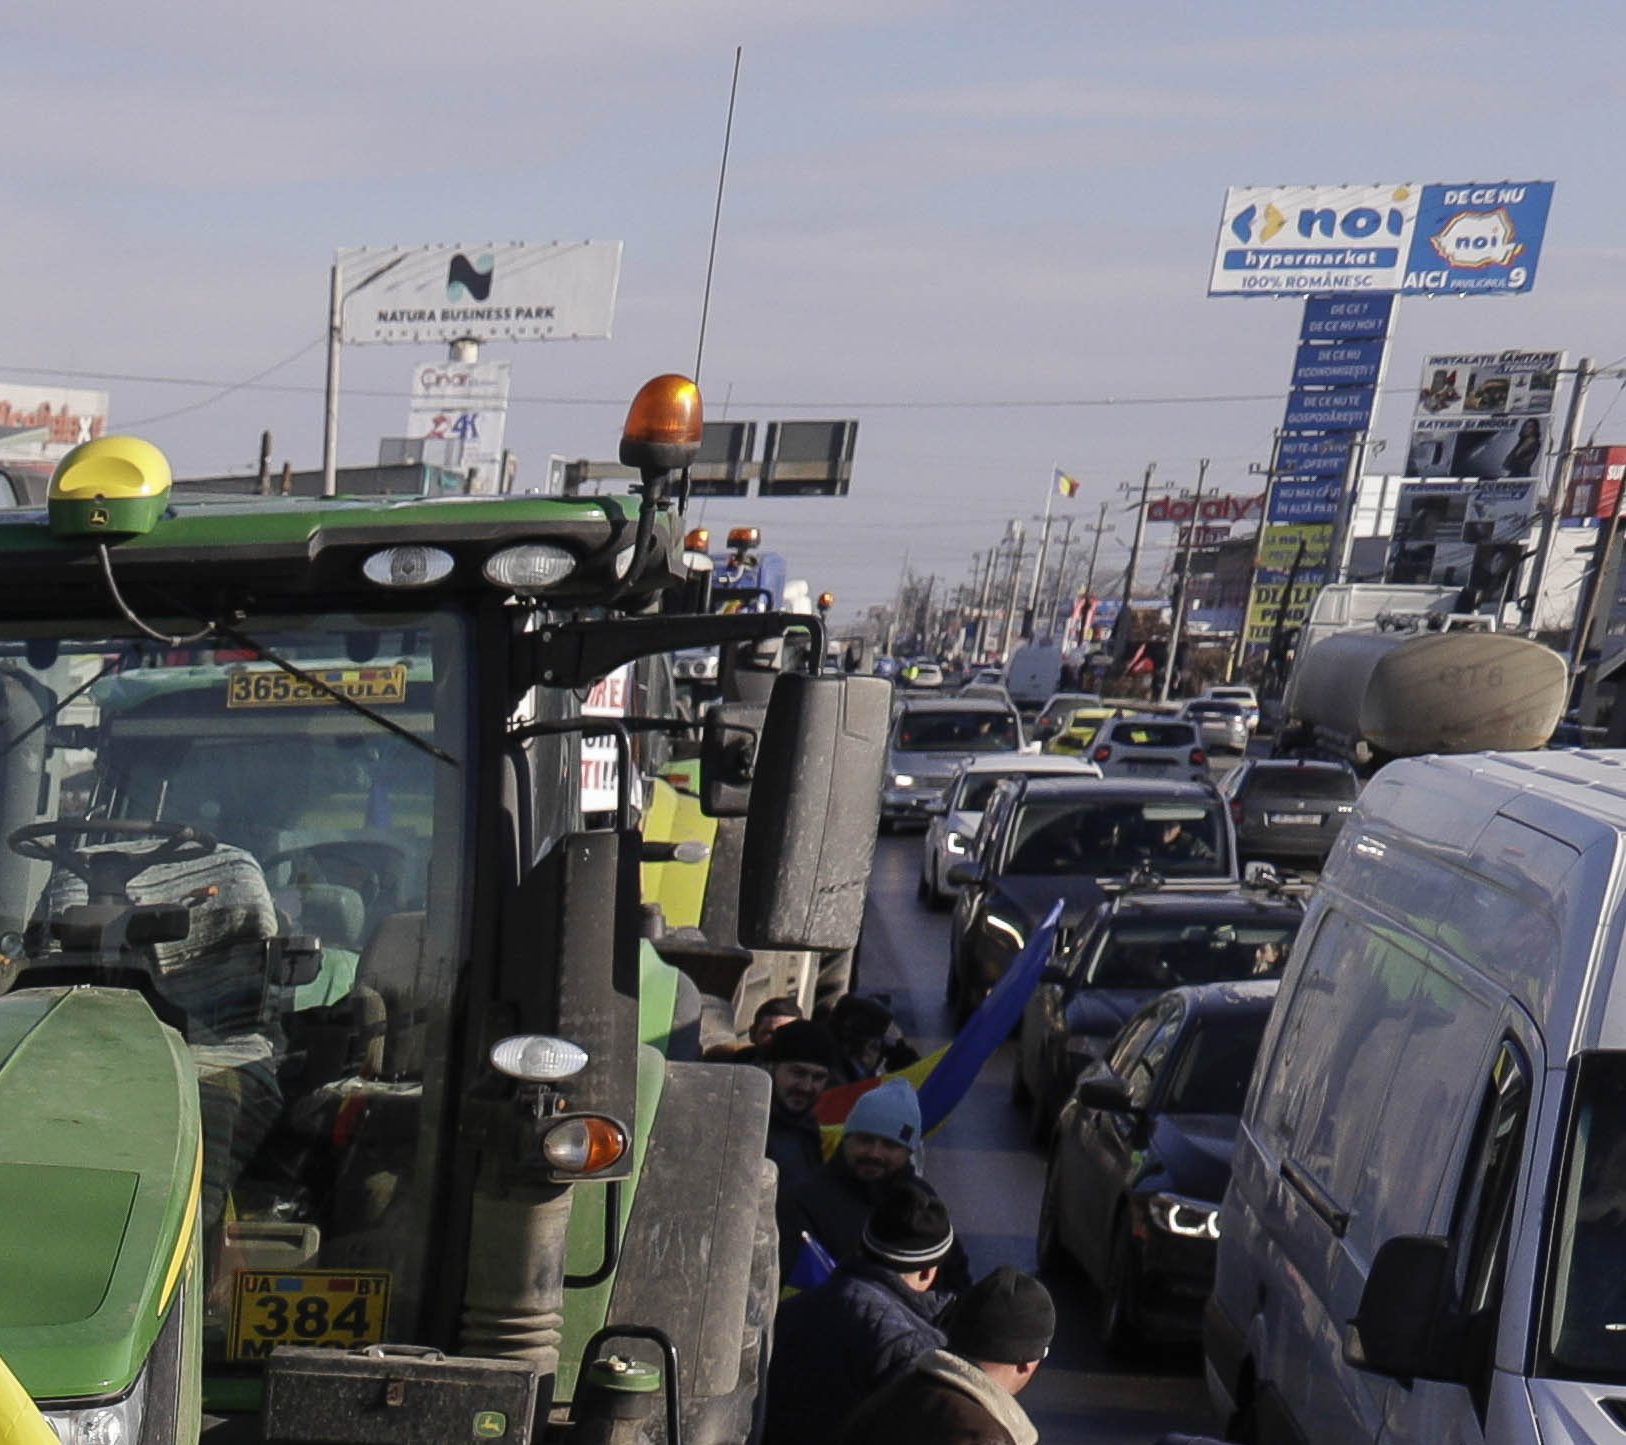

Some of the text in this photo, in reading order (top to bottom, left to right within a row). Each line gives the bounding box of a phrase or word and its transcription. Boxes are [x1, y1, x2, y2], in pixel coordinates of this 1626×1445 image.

[1444, 187, 1527, 206] DE CE NU
[1297, 187, 1410, 240] noi
[1245, 250, 1378, 269] hypermarket
[1404, 271, 1450, 288] AICI
[1507, 267, 1527, 288] 9
[377, 306, 555, 322] NATURA BUSINESS PARK
[1149, 493, 1256, 522] doaly
[234, 674, 291, 701] 365
[243, 1276, 384, 1295] UA BT
[252, 1295, 372, 1339] 384
